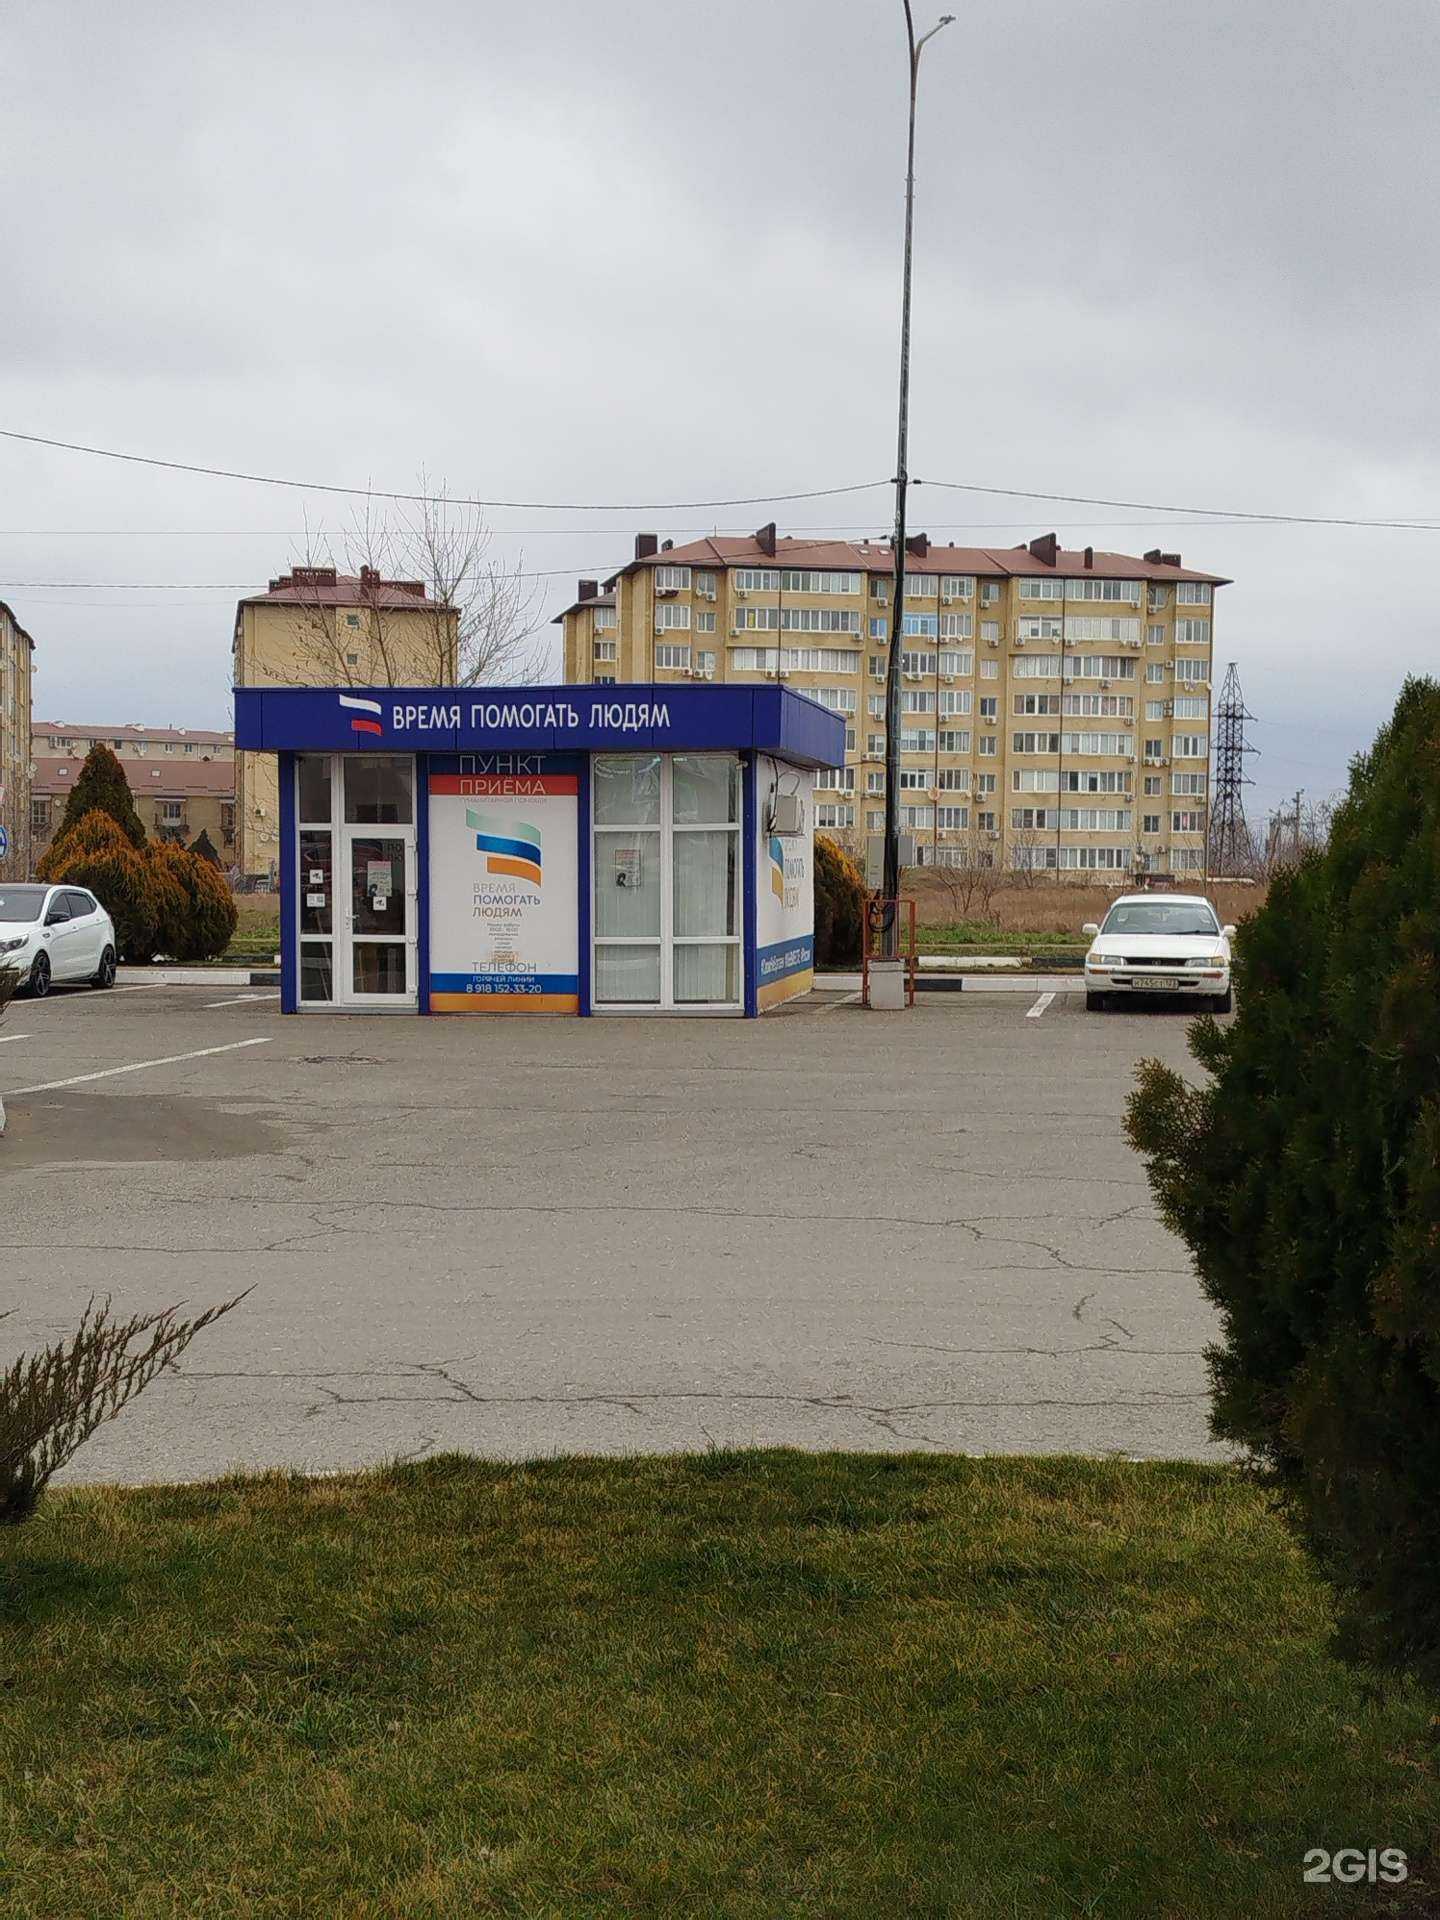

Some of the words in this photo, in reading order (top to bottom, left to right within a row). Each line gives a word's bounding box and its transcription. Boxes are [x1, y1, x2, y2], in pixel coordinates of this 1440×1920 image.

[392, 705, 461, 730] ВРЕМЯ
[470, 704, 579, 729] ПОМОГАТЬ
[588, 703, 671, 732] ЛЮДЯМ
[459, 755, 547, 774] ПУНКТ
[459, 776, 547, 794] ПРИЁМА
[473, 883, 516, 893] ВРЕМЯ
[473, 895, 541, 905] ПОМОГАТЬ
[473, 907, 522, 918] ЛЮДЯМ
[472, 962, 537, 973] ТЕЛЕФОН
[473, 975, 507, 983] ГОРЯЧЕЙ
[466, 984, 473, 993] 8
[475, 984, 492, 993] 918
[494, 984, 542, 993] 152-33-20
